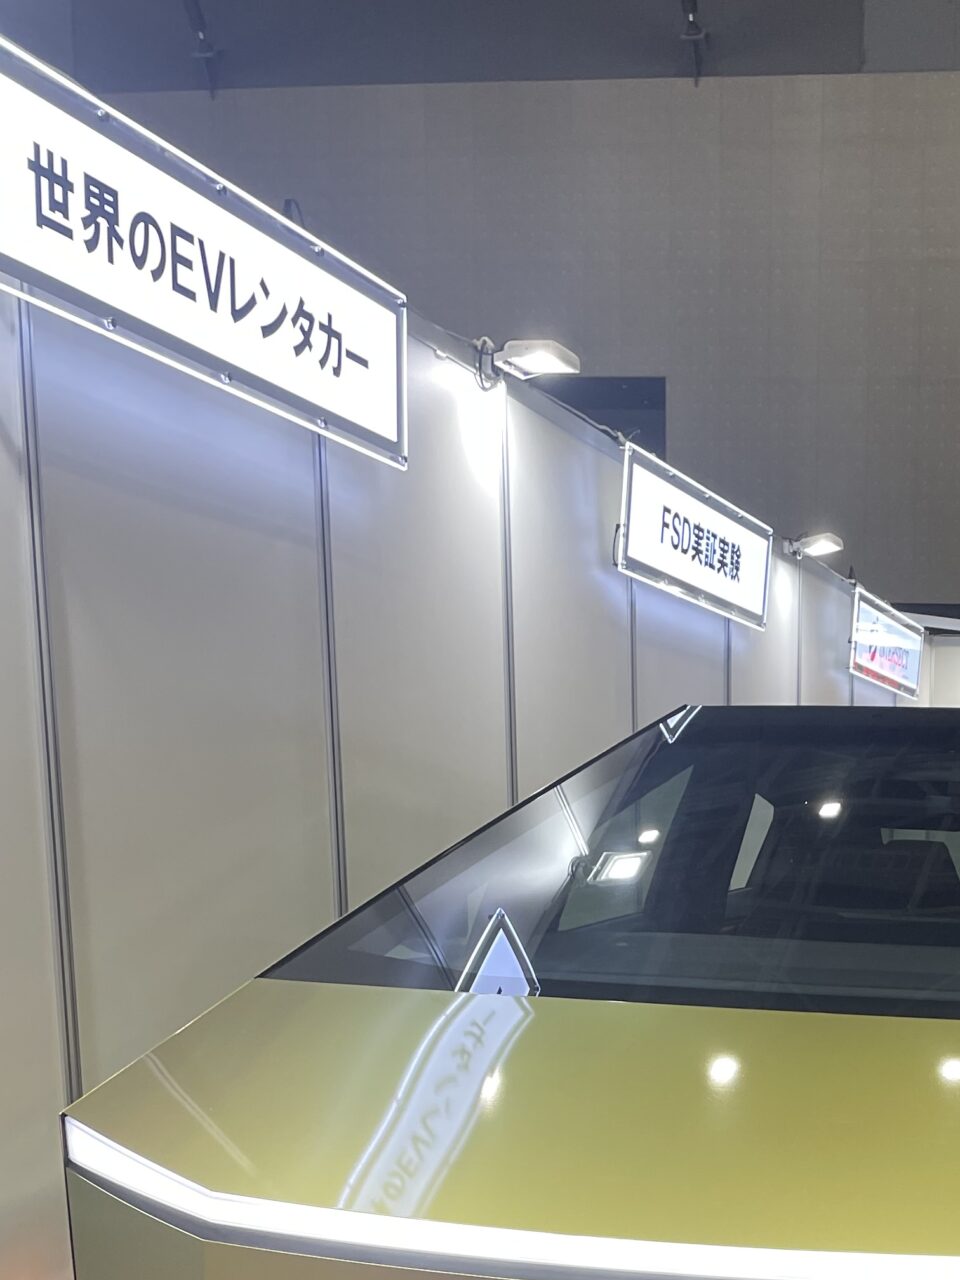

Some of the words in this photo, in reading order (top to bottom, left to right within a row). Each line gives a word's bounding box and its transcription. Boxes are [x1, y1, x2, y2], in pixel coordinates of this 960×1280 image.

[27, 141, 369, 377] 世界のEVレンタカー
[660, 504, 742, 583] FSD実証実験
